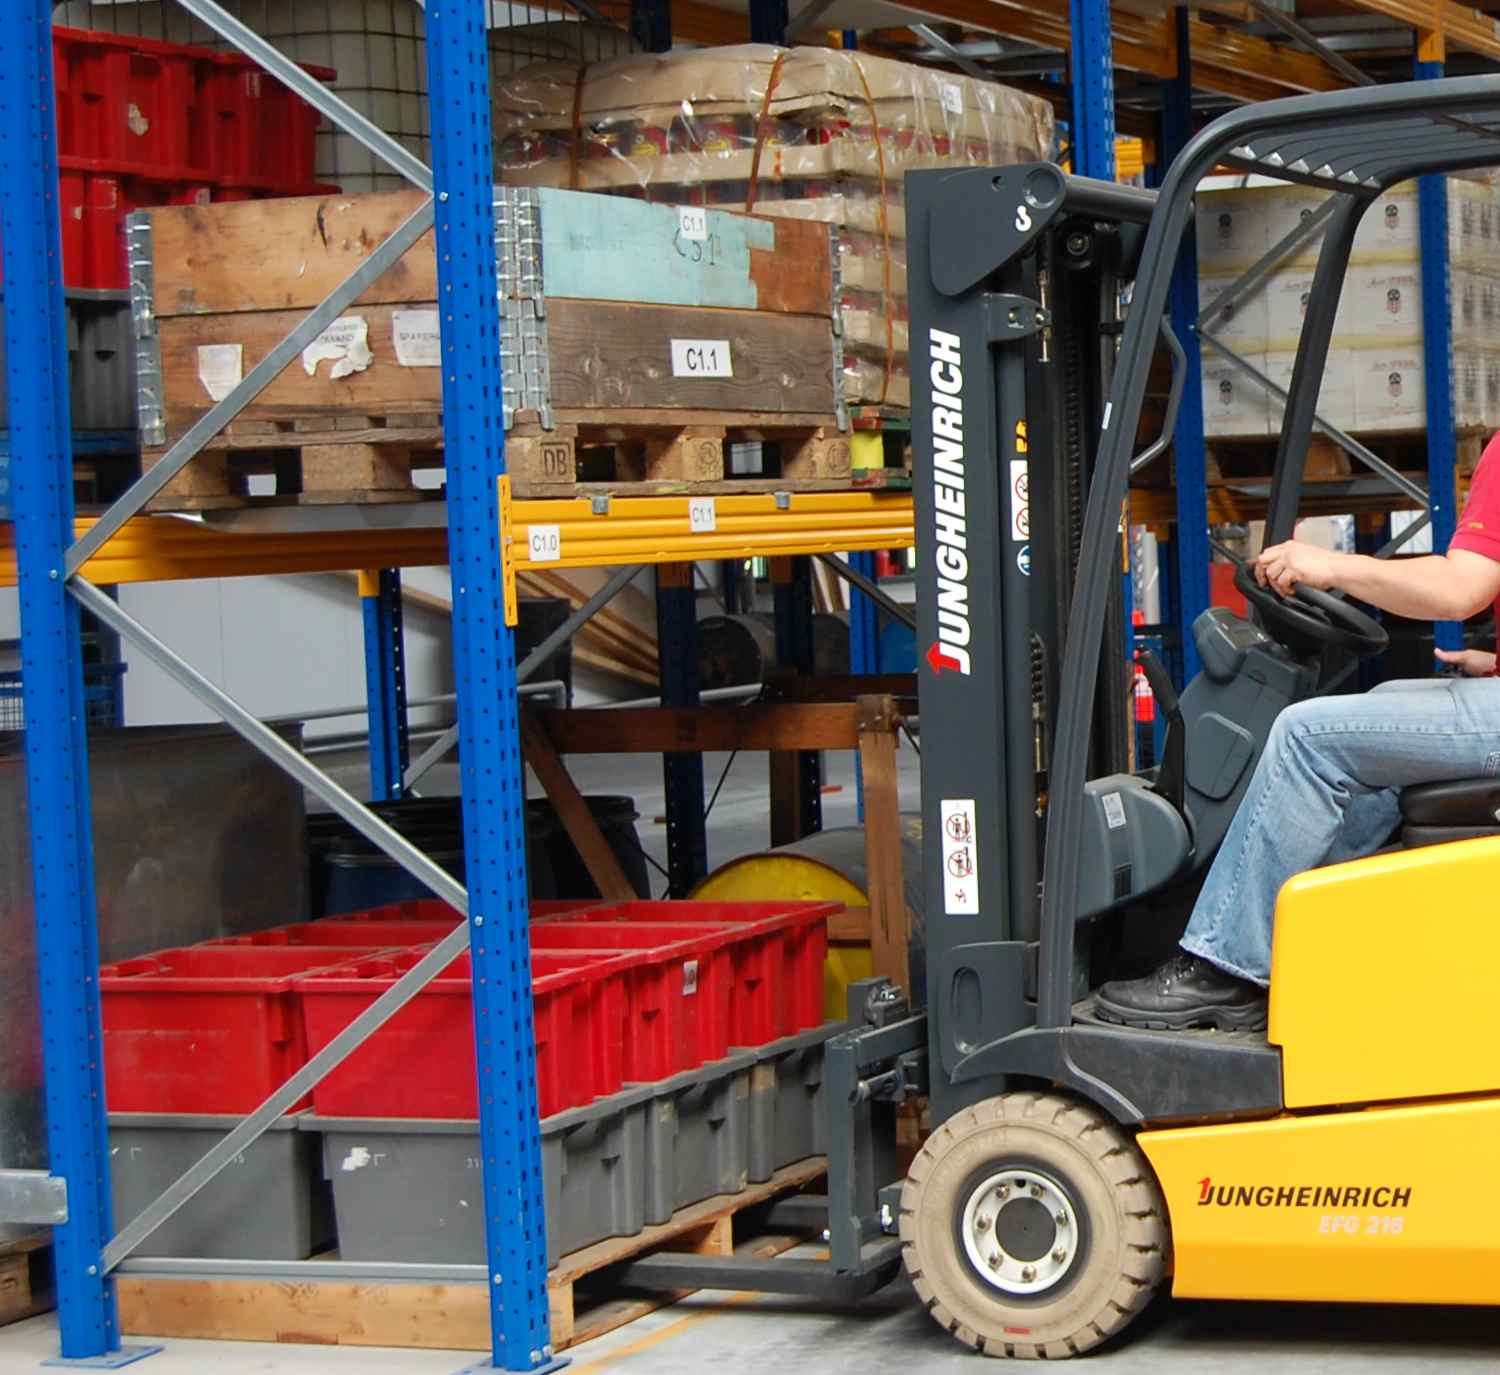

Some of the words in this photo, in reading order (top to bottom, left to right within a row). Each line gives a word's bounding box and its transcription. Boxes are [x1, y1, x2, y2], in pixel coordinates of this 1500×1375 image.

[682, 215, 704, 231] C1.1
[686, 347, 718, 371] C1.1
[543, 448, 567, 476] DB
[929, 328, 971, 675] JUNGHEINRICH
[692, 506, 712, 523] C1.1
[532, 534, 557, 552] C1.0
[1198, 1184, 1412, 1208] JUNGHEINRICH
